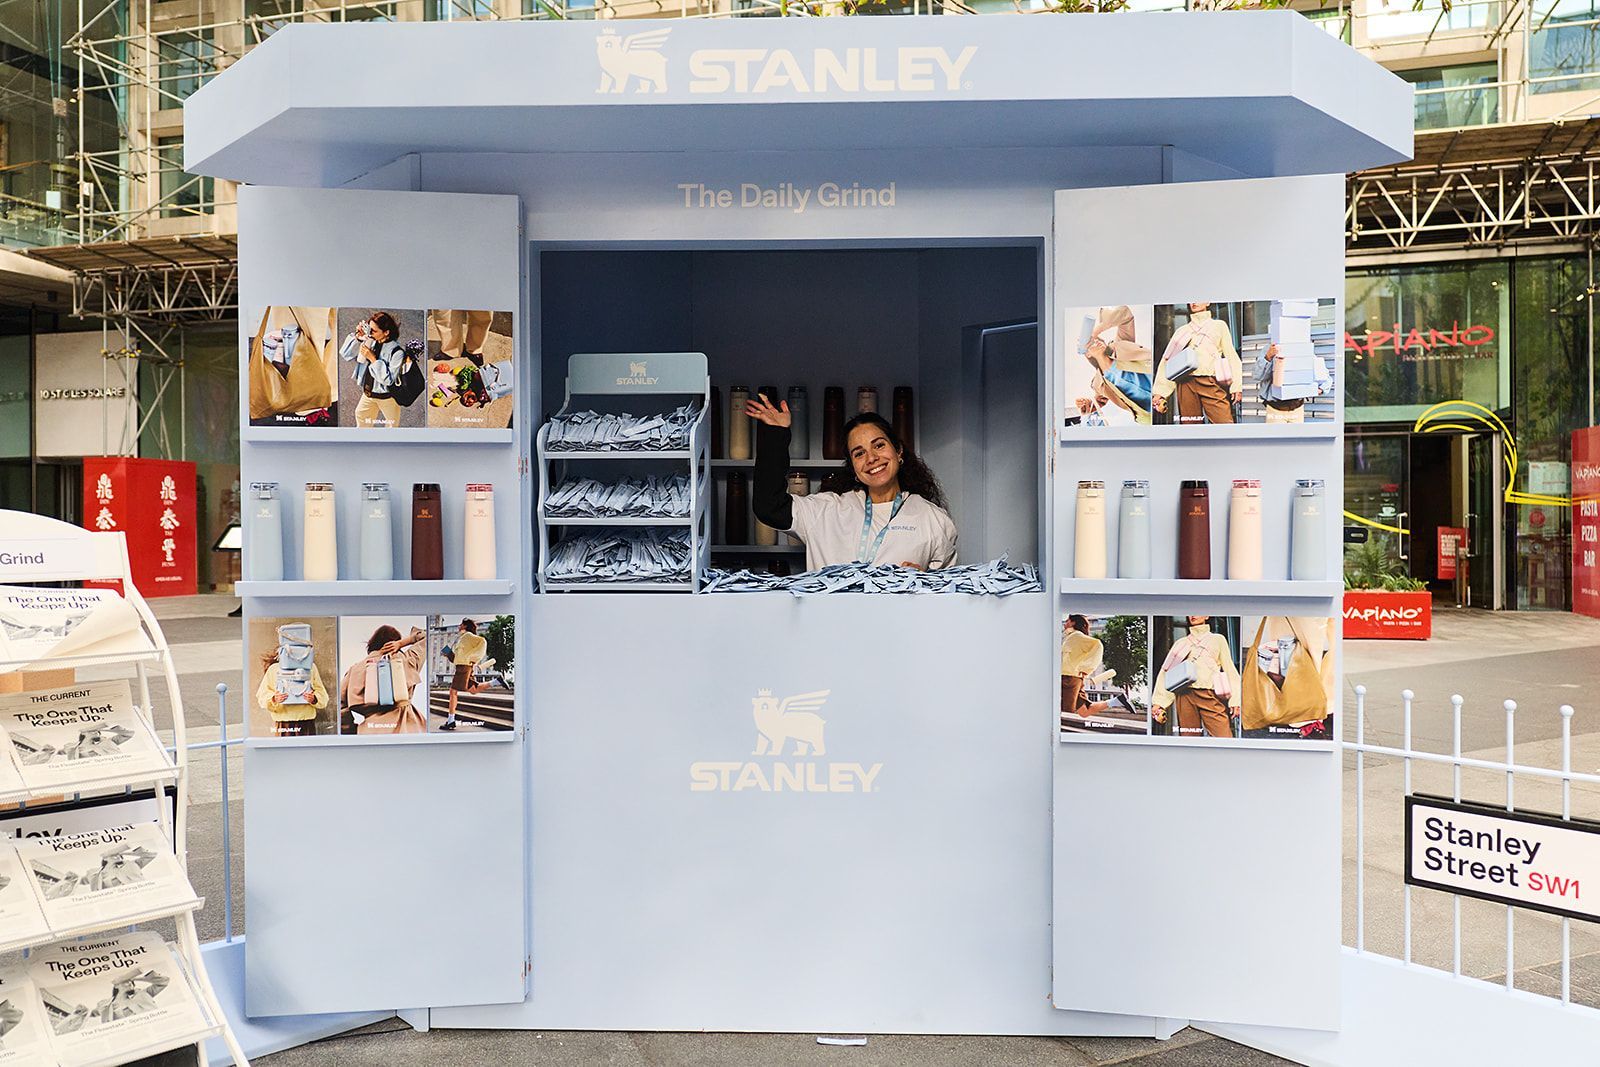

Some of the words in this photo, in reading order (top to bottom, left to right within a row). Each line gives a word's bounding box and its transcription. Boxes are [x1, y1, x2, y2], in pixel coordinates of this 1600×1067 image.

[678, 184, 732, 208] The
[741, 182, 811, 213] Daily
[817, 182, 896, 209] Grind
[615, 377, 659, 385] STANLEY
[1580, 500, 1599, 517] PASTA
[1581, 525, 1598, 543] PIZZA
[0, 552, 44, 565] Grind
[1584, 550, 1596, 567] BAR
[30, 695, 49, 703] THE
[50, 689, 92, 701] CURRENT
[13, 713, 44, 722] The
[47, 709, 77, 718] One
[78, 703, 114, 714] That
[31, 717, 78, 727] Keeps
[80, 714, 105, 723] Up.
[53, 837, 99, 852] Keeps
[102, 833, 127, 845] Up.
[1424, 817, 1541, 865] Stanley
[1424, 847, 1519, 887] Street
[1528, 872, 1580, 899] SW1
[79, 939, 119, 952] CURRENT
[45, 961, 76, 972] The
[78, 955, 110, 967] One
[110, 946, 147, 960] That
[62, 968, 111, 981] Keeps
[112, 960, 138, 971] Up.
